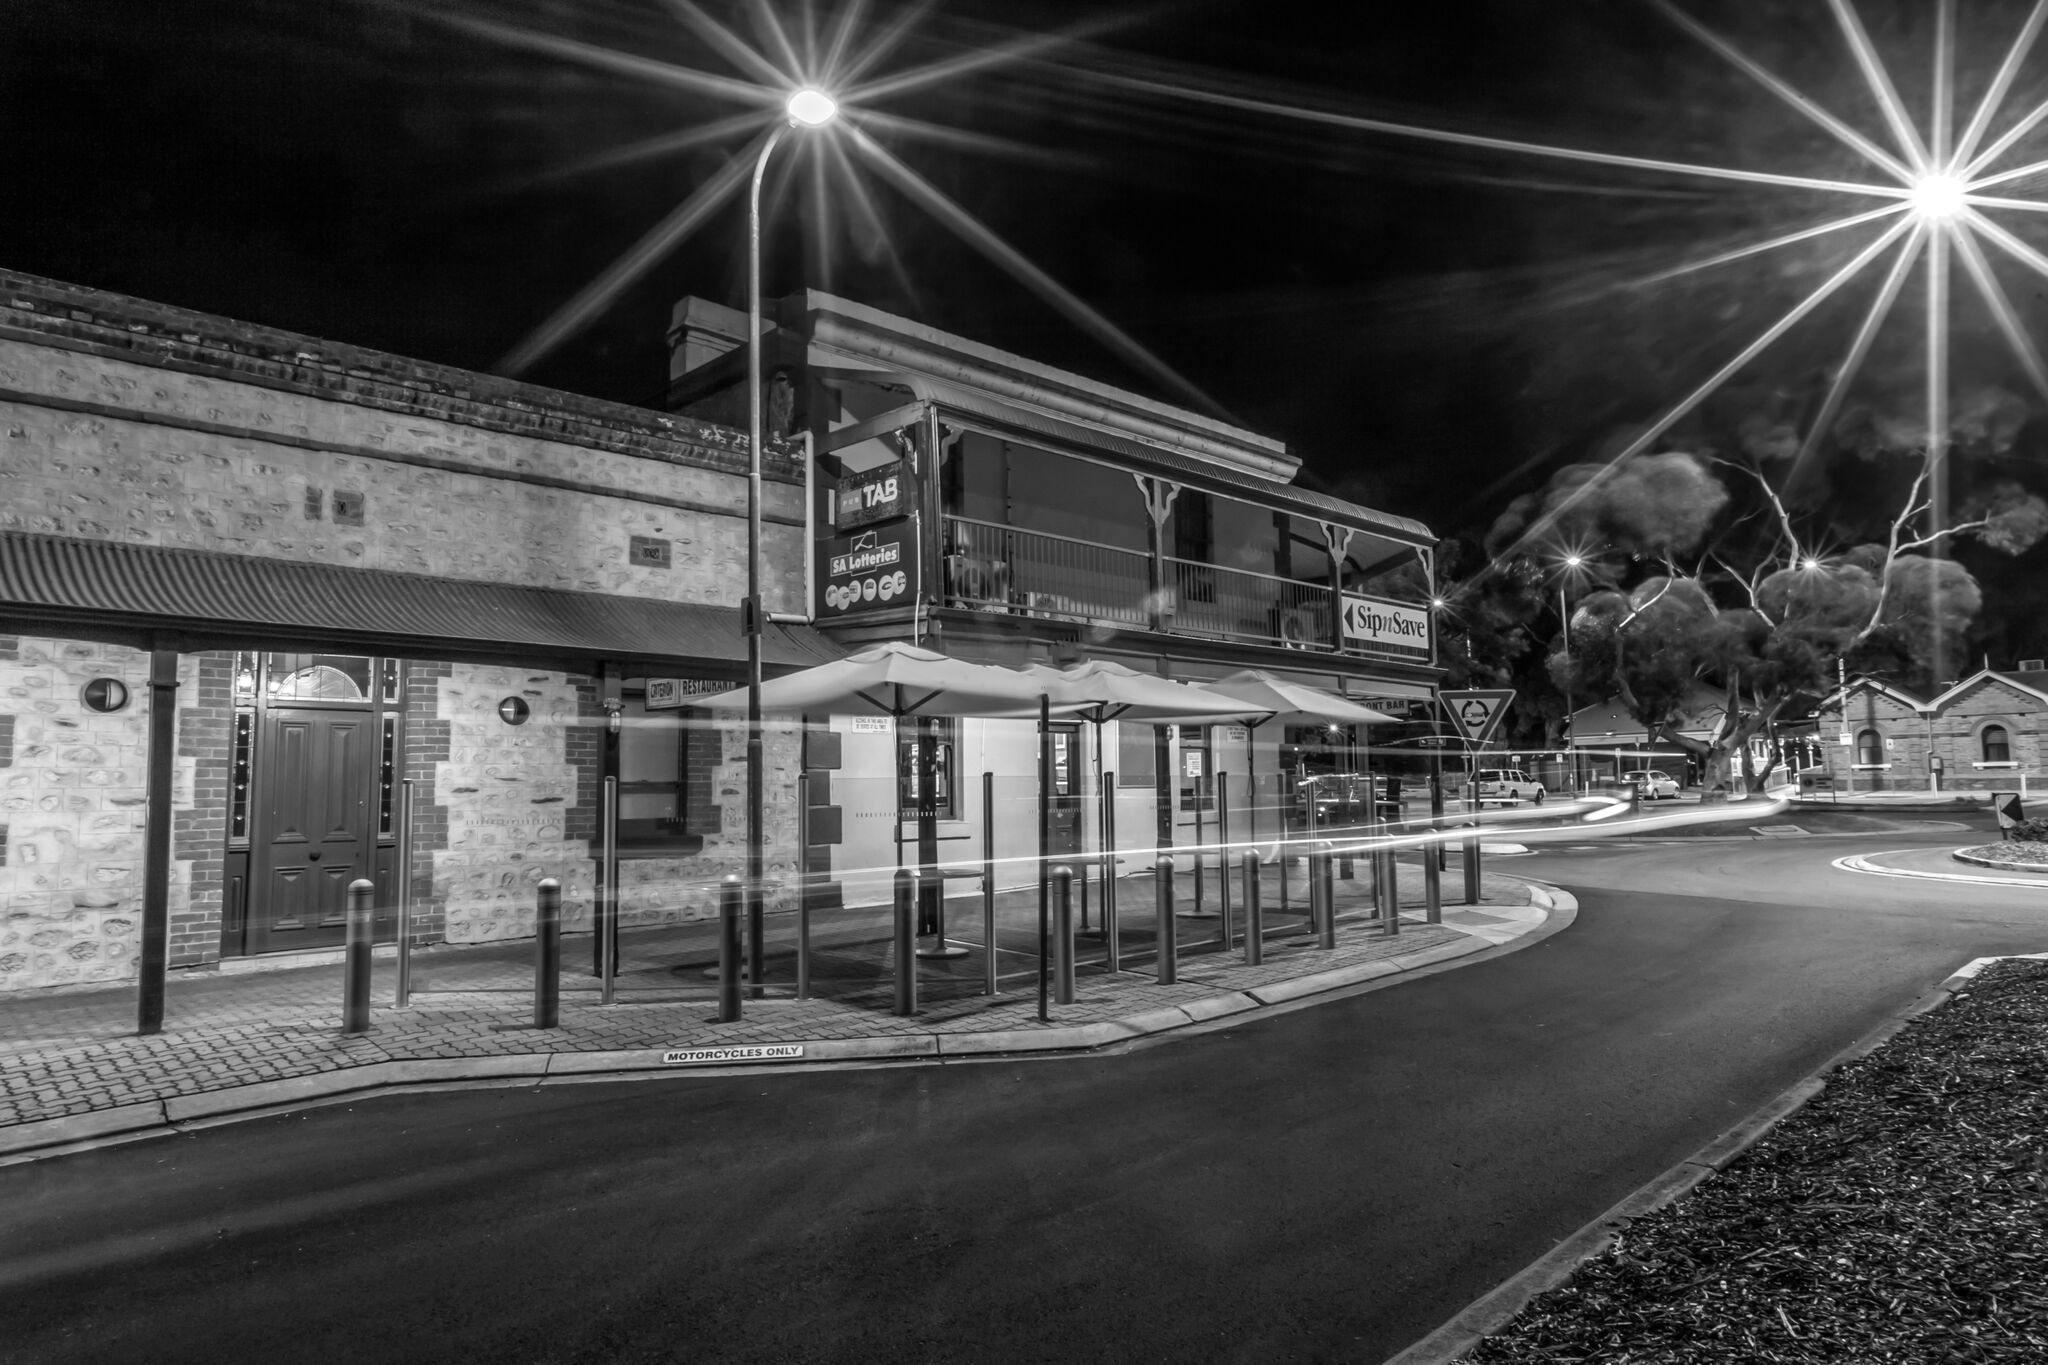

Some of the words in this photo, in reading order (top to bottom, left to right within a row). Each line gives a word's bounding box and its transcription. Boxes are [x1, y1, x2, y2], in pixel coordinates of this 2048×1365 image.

[863, 478, 898, 508] TAB
[832, 558, 847, 574] SA
[849, 547, 897, 570] Lotteries
[1386, 700, 1405, 710] BAR
[667, 1047, 762, 1061] MOTORCYCLES
[766, 1046, 799, 1057] ONLY
